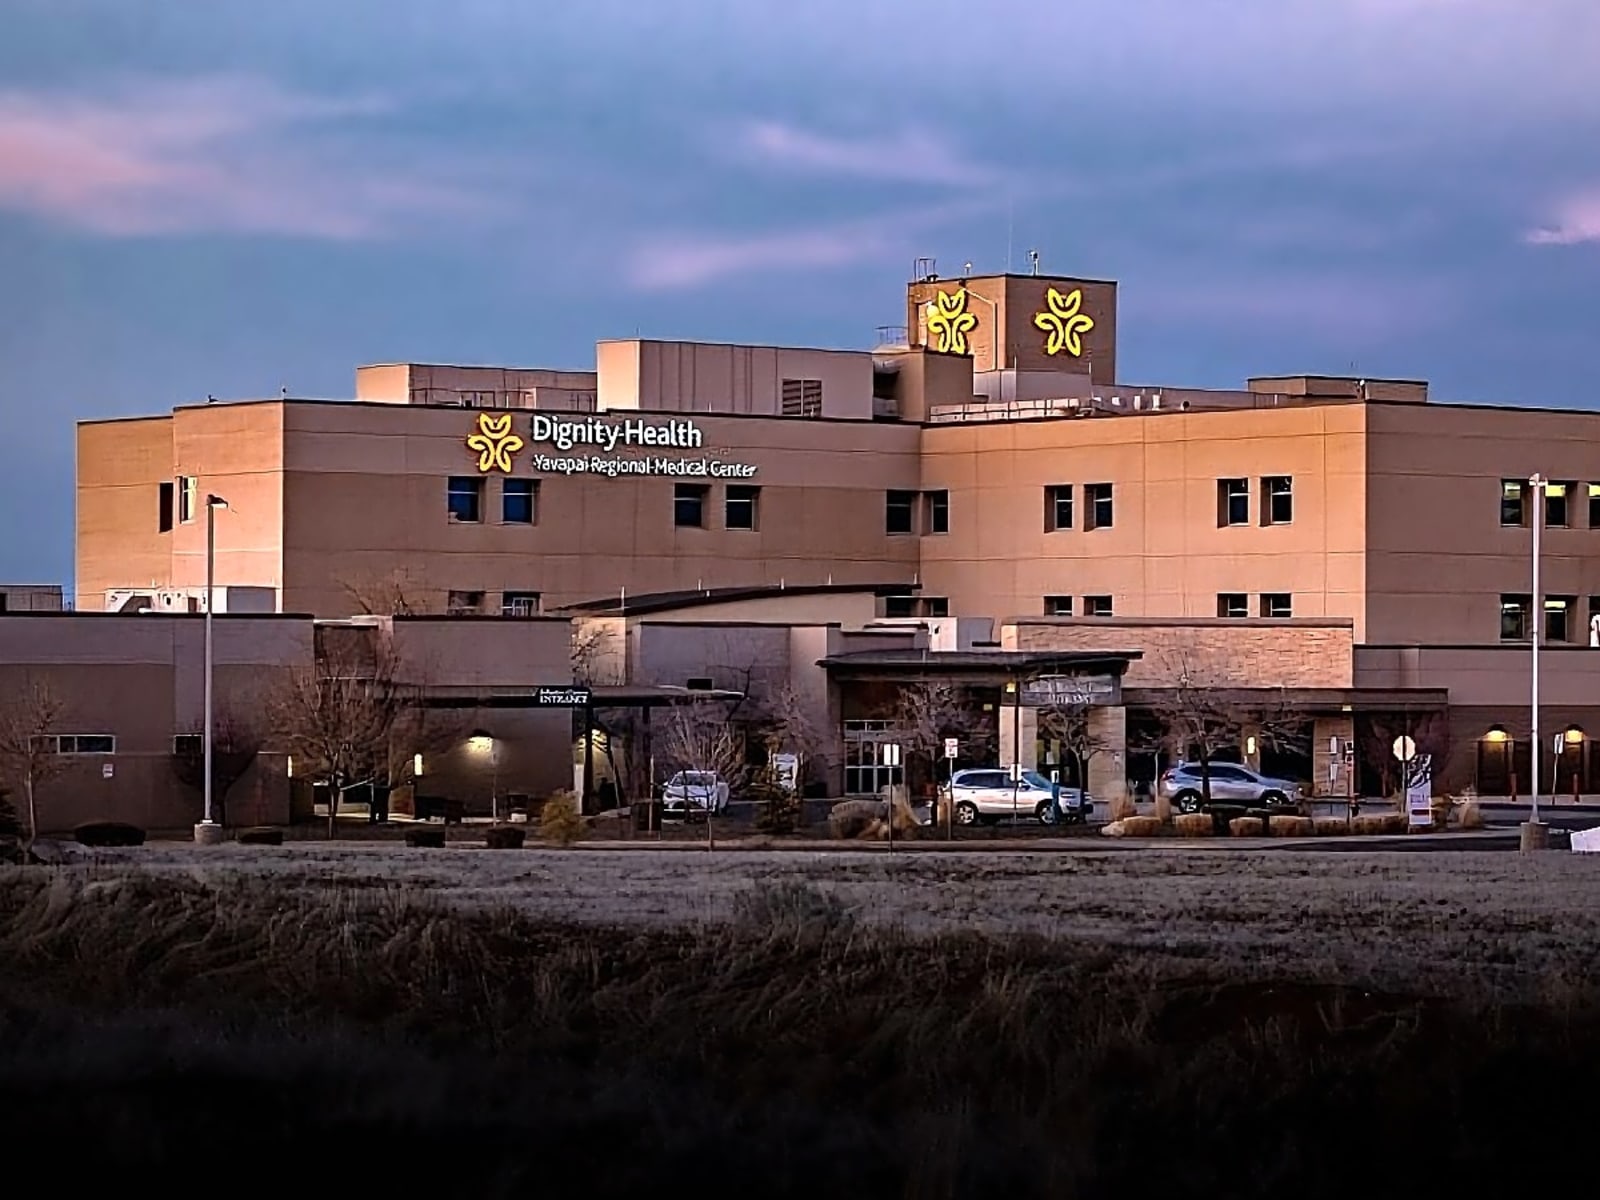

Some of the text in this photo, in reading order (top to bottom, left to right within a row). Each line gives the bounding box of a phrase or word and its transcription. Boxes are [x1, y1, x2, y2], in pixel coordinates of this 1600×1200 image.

[532, 415, 702, 452] Dignity Health
[532, 453, 757, 477] Yavapai Regional Medical Center
